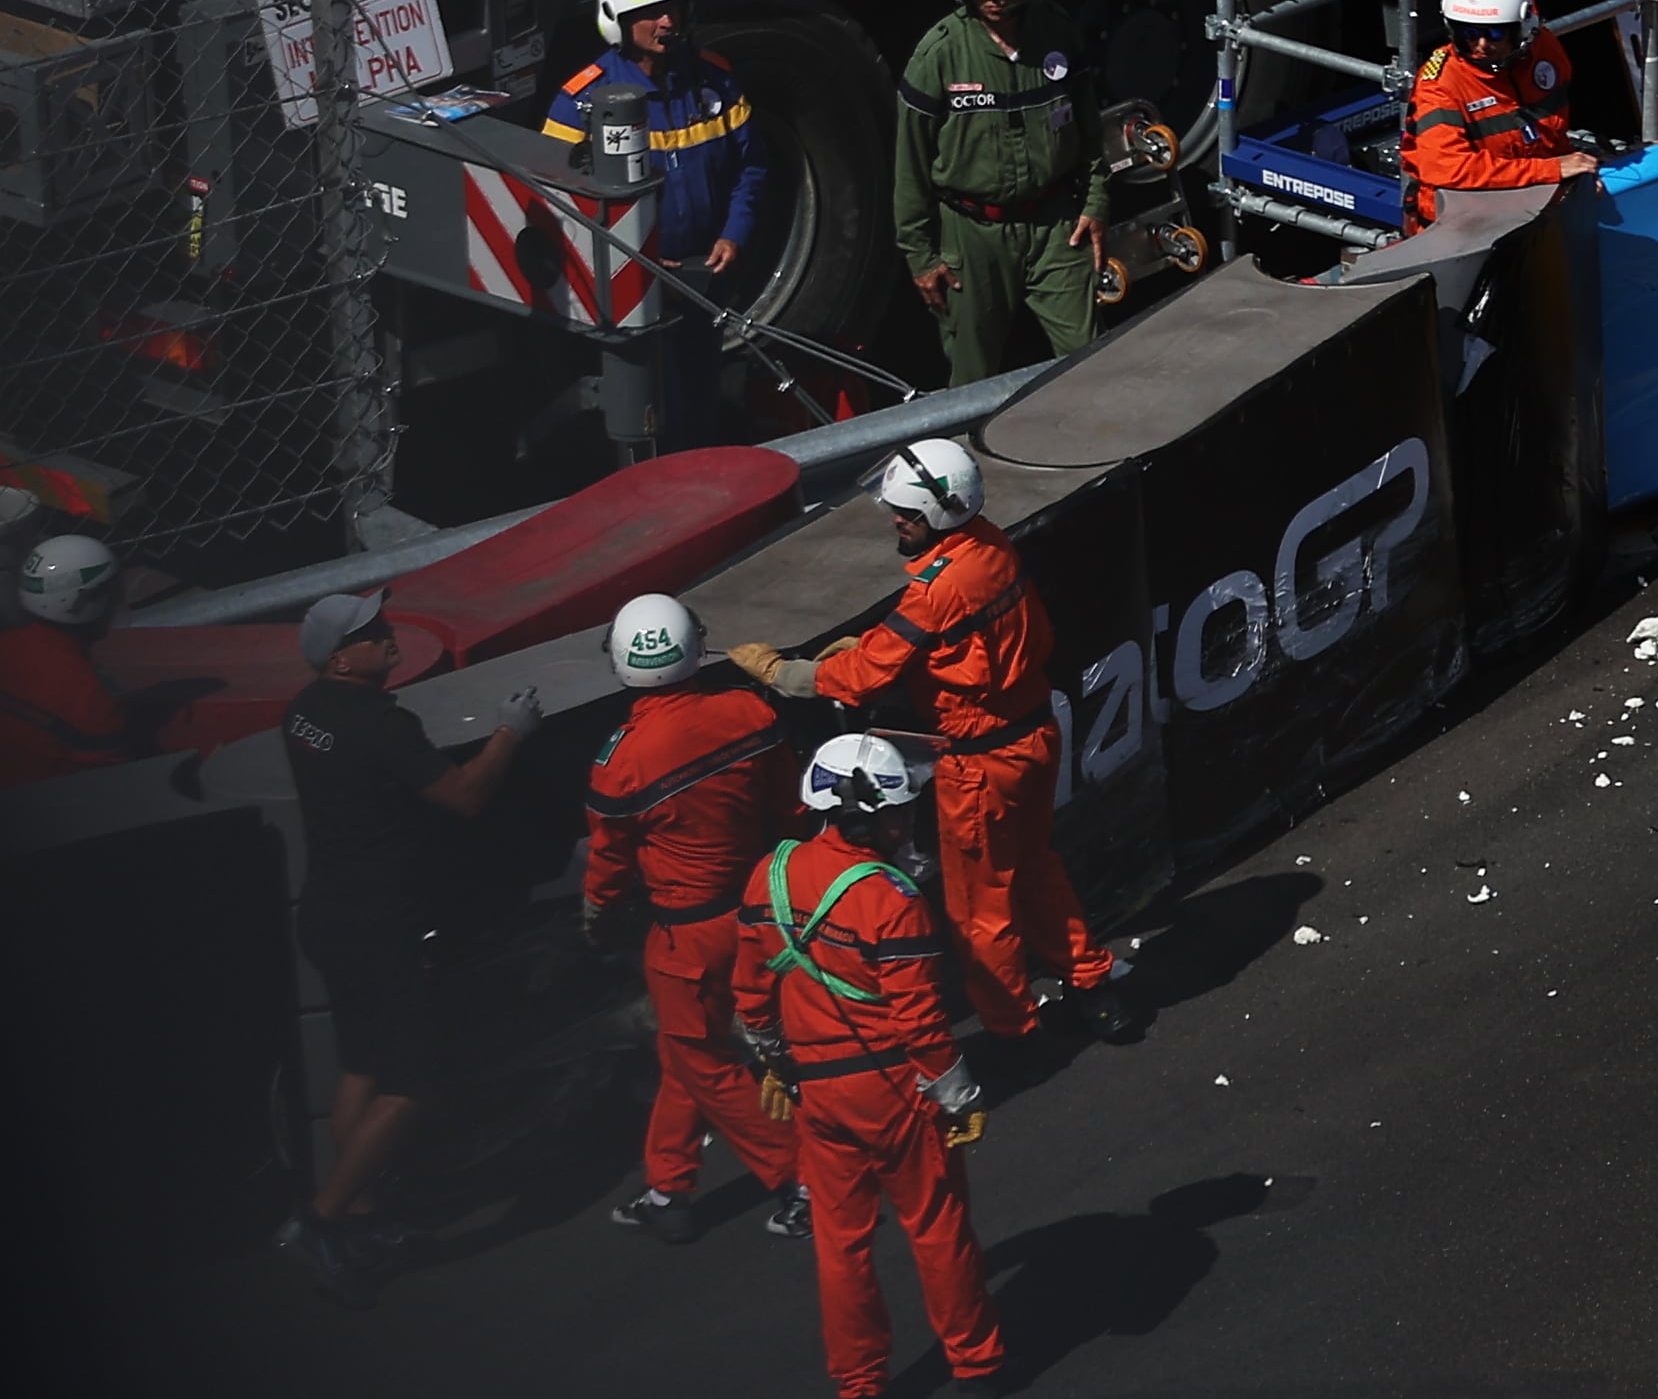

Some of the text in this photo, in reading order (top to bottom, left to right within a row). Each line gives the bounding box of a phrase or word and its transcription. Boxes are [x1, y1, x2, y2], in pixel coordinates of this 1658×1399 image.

[1335, 101, 1401, 133] TREPOSE
[1525, 126, 1535, 140] 1
[1261, 168, 1356, 210] ENTREPOSE
[631, 626, 673, 652] 454
